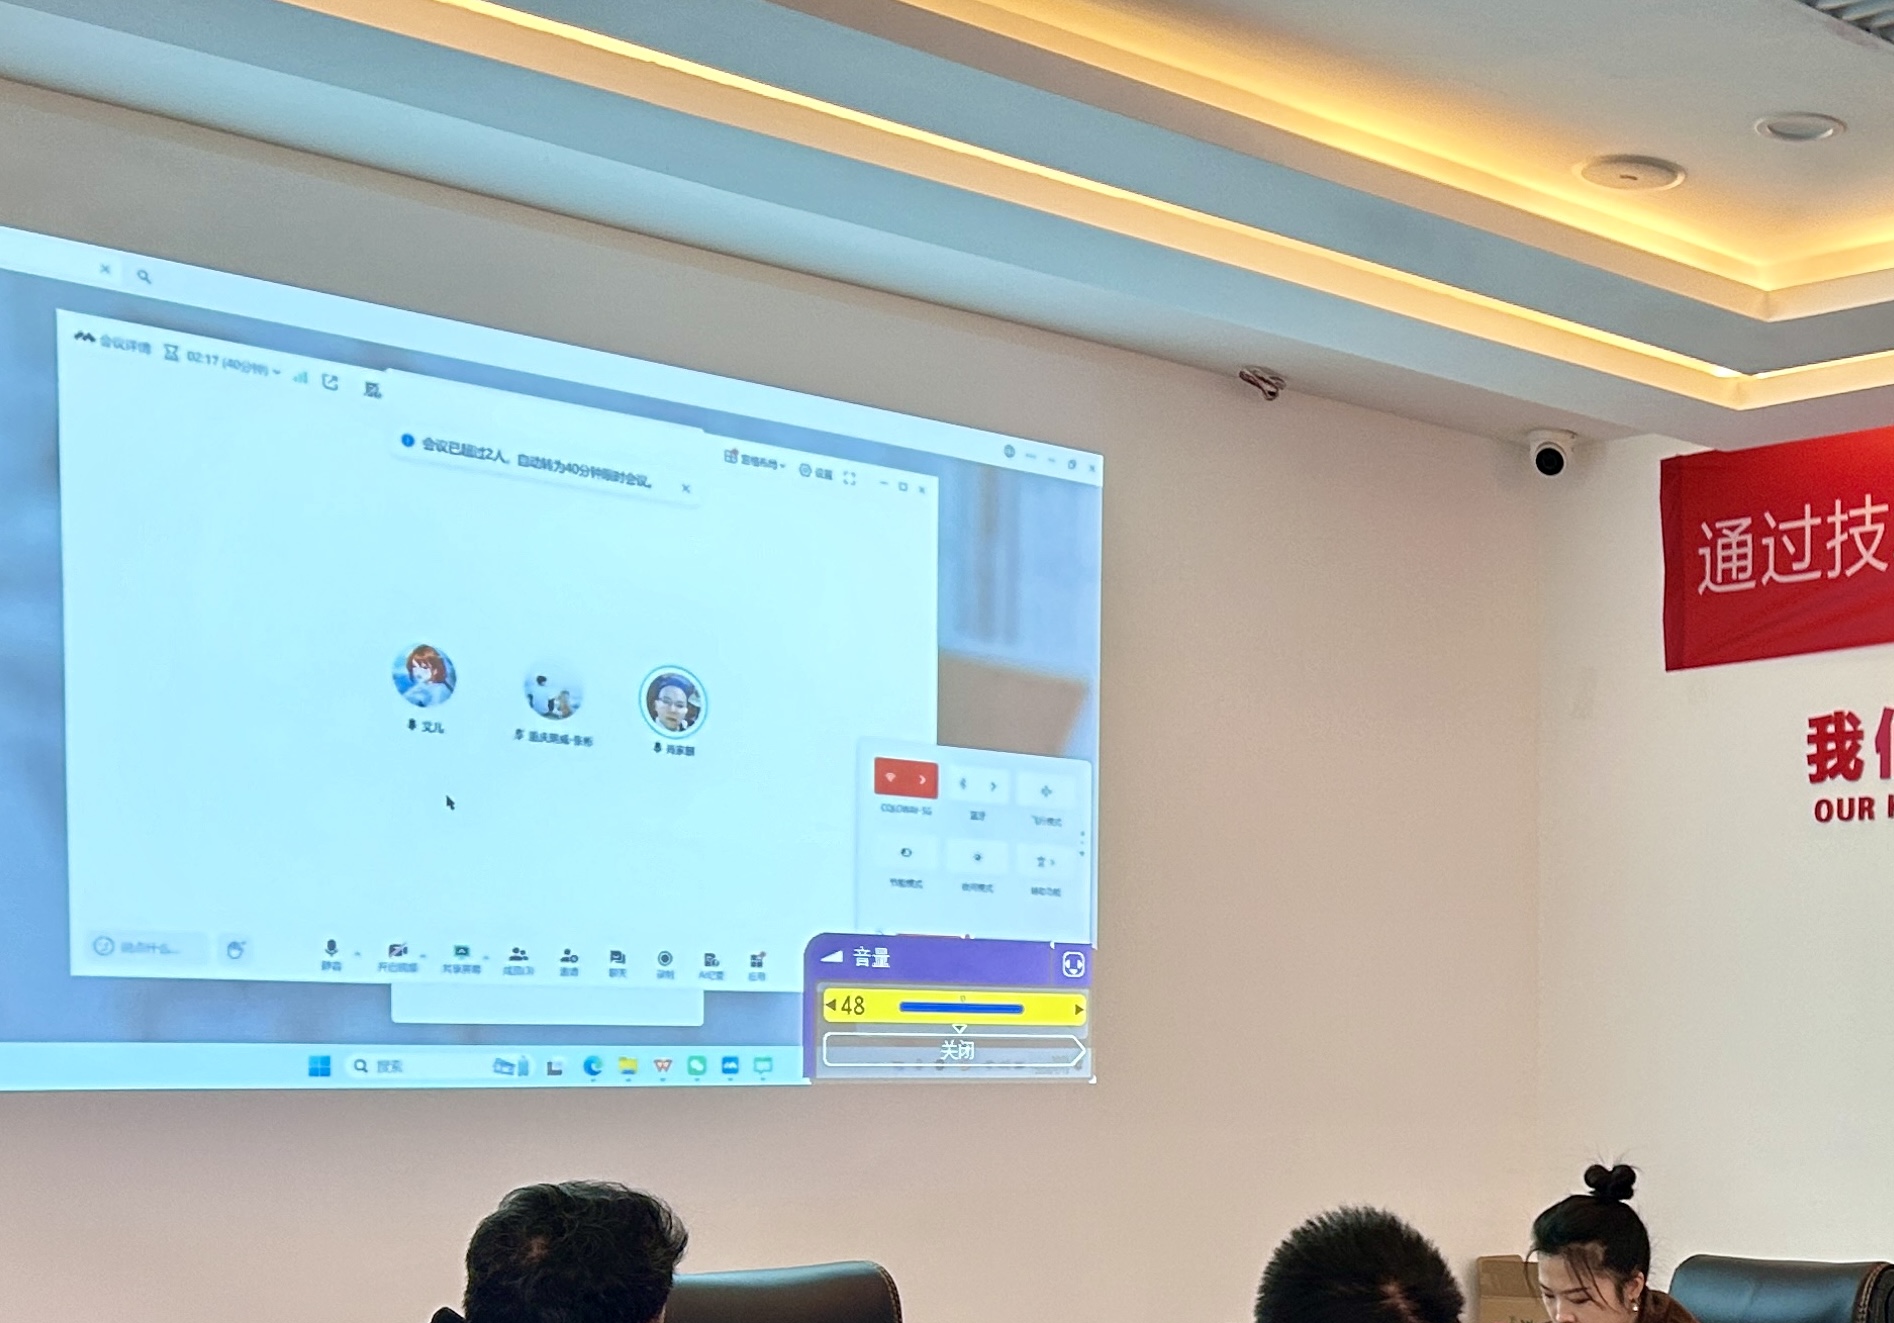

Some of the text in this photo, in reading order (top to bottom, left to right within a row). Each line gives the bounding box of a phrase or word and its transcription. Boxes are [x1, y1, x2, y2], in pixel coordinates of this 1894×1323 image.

[1814, 797, 1875, 822] OUR
[853, 945, 891, 968] 音量
[841, 995, 865, 1016] 48
[940, 1039, 975, 1061] 关闭
